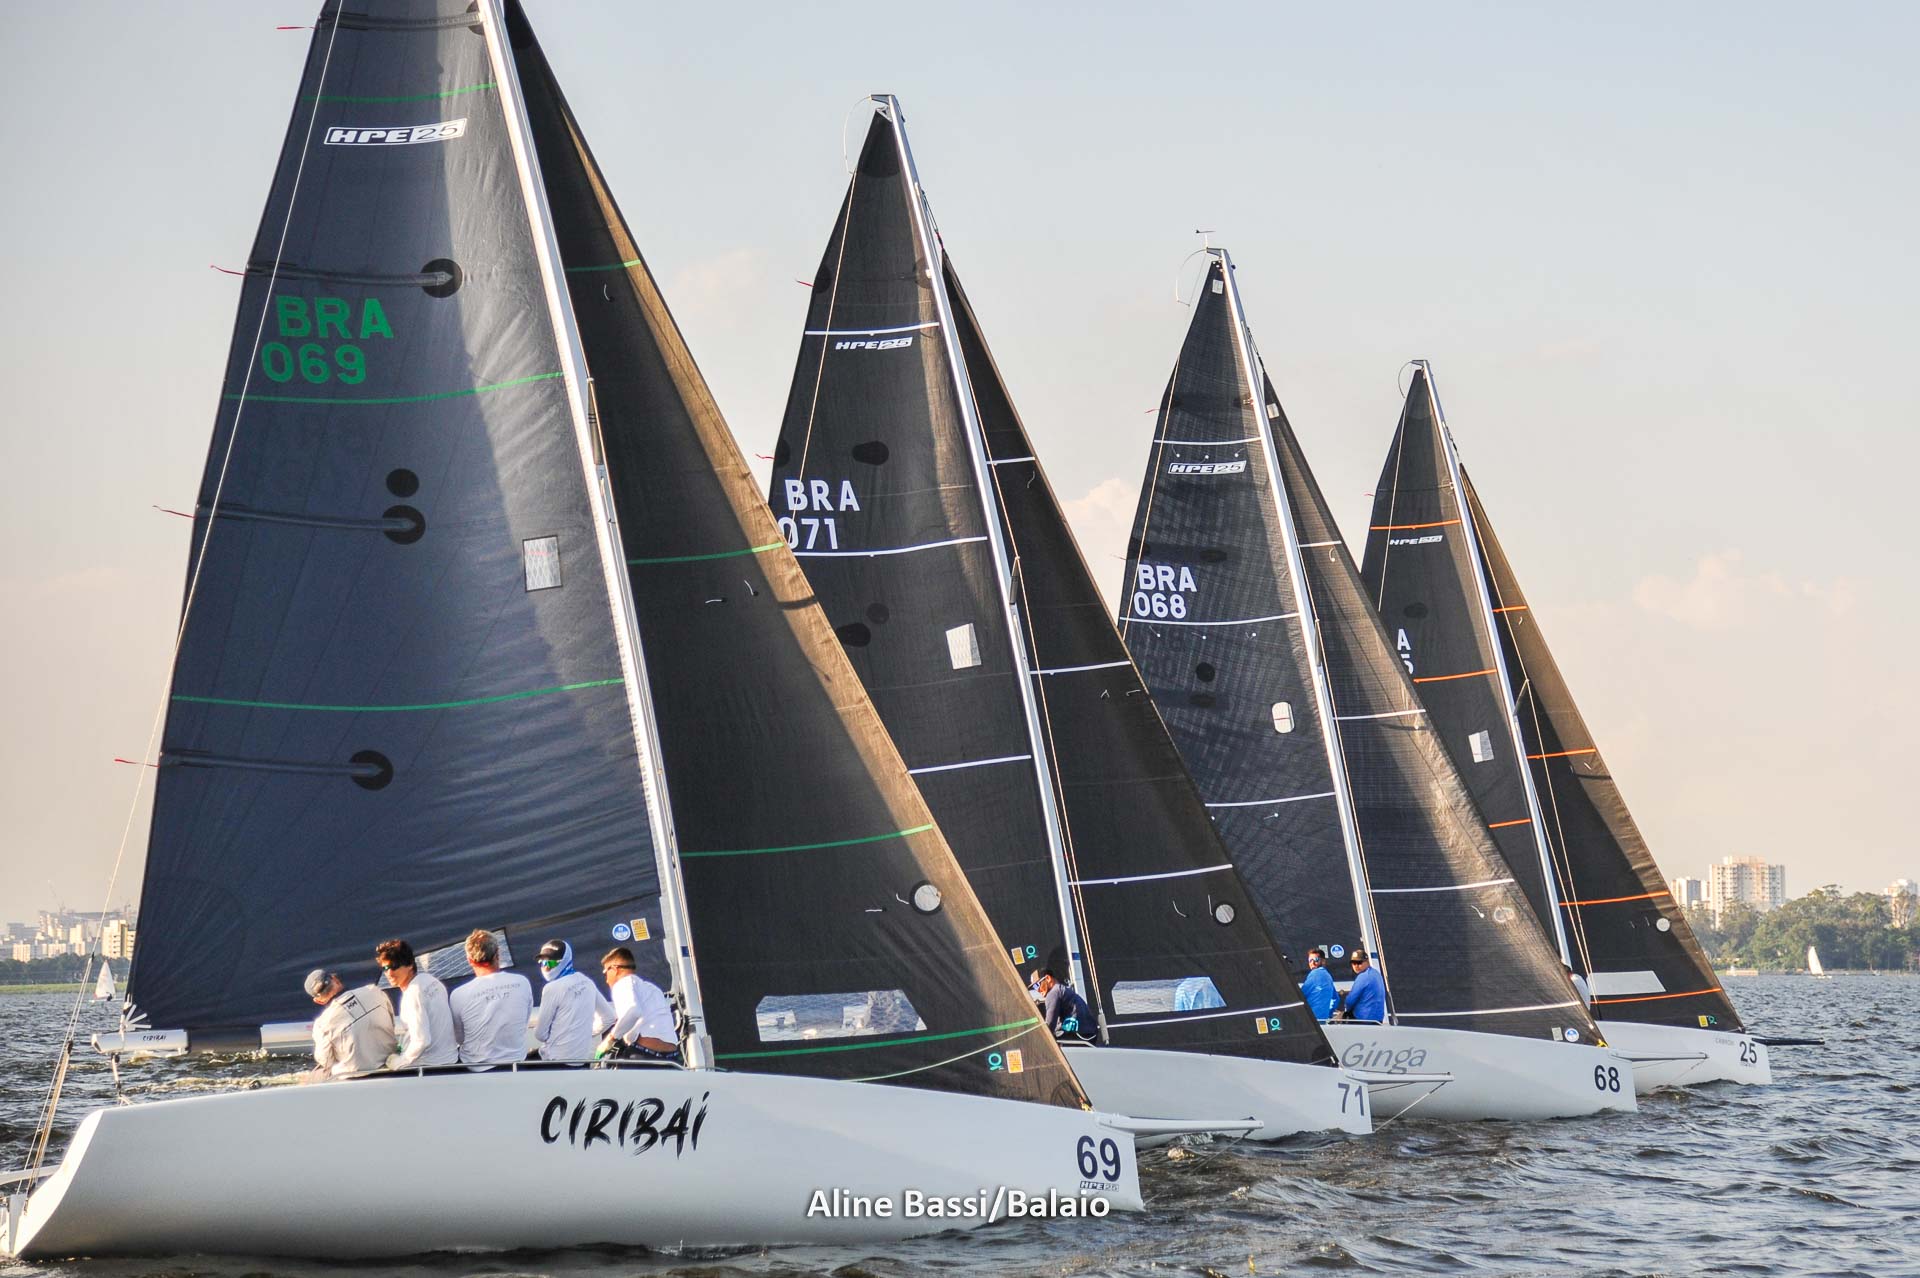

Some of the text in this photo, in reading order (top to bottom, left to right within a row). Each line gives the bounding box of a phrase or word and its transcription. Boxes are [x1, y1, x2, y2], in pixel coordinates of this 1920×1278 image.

[326, 121, 462, 144] HPE25
[276, 295, 394, 339] BRA
[261, 342, 367, 384] 069
[1169, 461, 1245, 474] HPE25
[784, 479, 861, 512] BRA
[778, 516, 839, 550] 071
[1138, 564, 1198, 592] BRA
[1133, 591, 1187, 619] 068
[1341, 1042, 1428, 1075] Ginga
[1740, 1041, 1757, 1064] 25
[1594, 1064, 1621, 1093] 68
[1337, 1082, 1365, 1116] 71
[1076, 1135, 1121, 1182] 69
